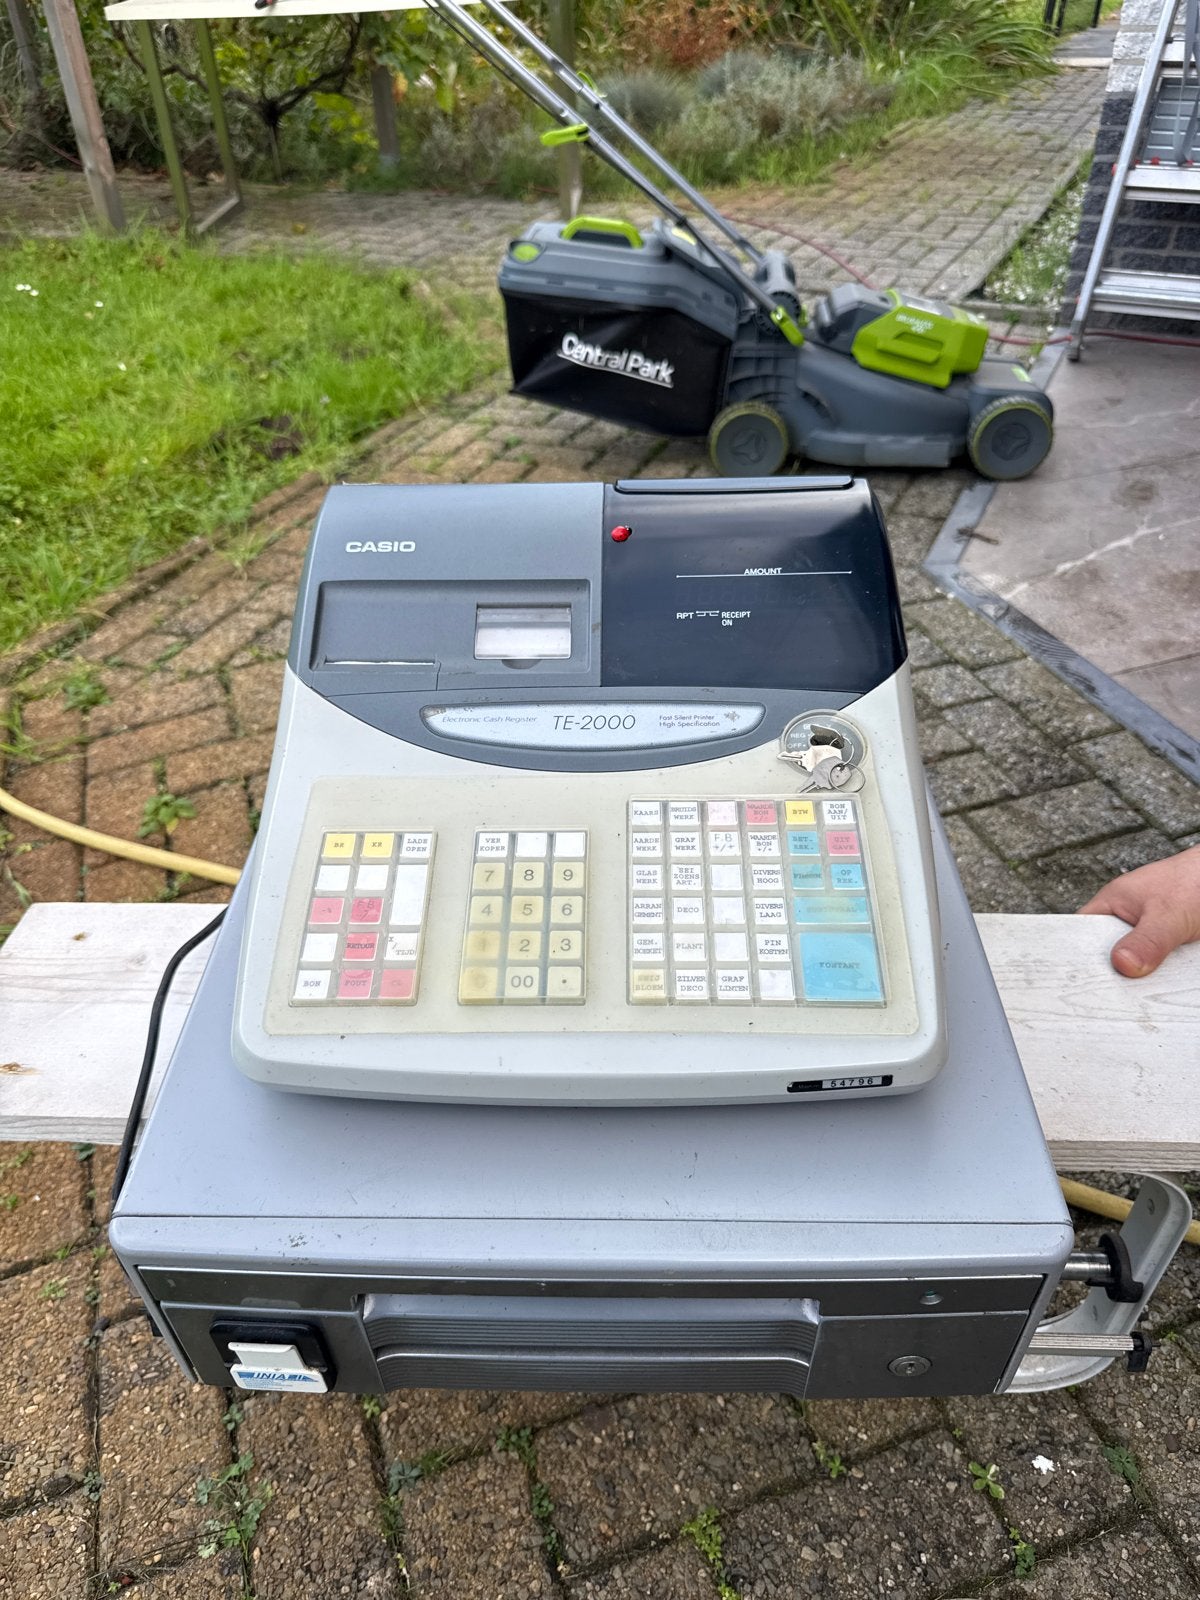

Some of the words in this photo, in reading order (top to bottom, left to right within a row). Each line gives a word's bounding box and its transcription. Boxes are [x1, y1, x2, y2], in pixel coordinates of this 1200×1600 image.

[345, 541, 416, 552] CASIO
[744, 567, 782, 575] AMOUNT
[721, 611, 751, 619] RECEIPT
[505, 716, 537, 724] Register
[553, 714, 636, 730] TE-2000
[484, 870, 495, 882] 7
[523, 869, 535, 881] 8
[562, 869, 573, 881] 9
[480, 903, 493, 916] 4
[521, 903, 533, 916] 5
[561, 903, 573, 916] 6
[519, 938, 531, 952] 2
[560, 938, 572, 952] 3
[510, 975, 534, 988] 00
[830, 1077, 874, 1088] 54796
